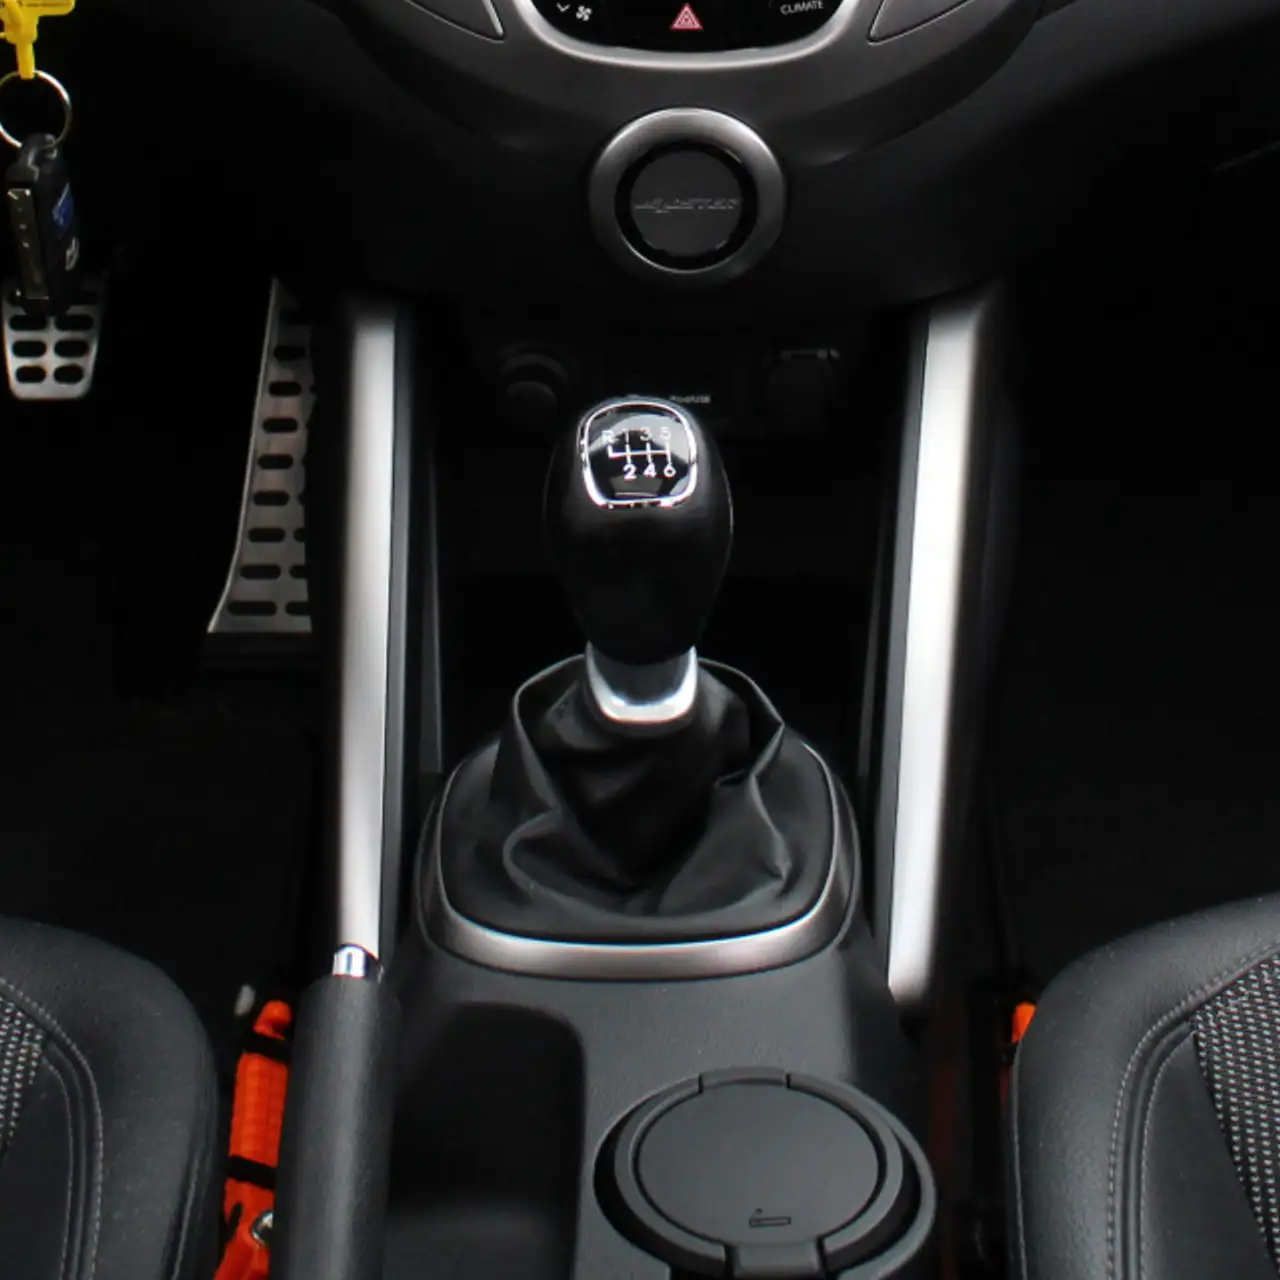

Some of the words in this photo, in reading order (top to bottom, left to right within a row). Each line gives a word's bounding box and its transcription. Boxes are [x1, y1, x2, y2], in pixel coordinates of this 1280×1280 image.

[780, 0, 824, 15] CLIMATE
[623, 464, 637, 480] 2
[643, 463, 657, 478] 4
[664, 464, 676, 477] 6
